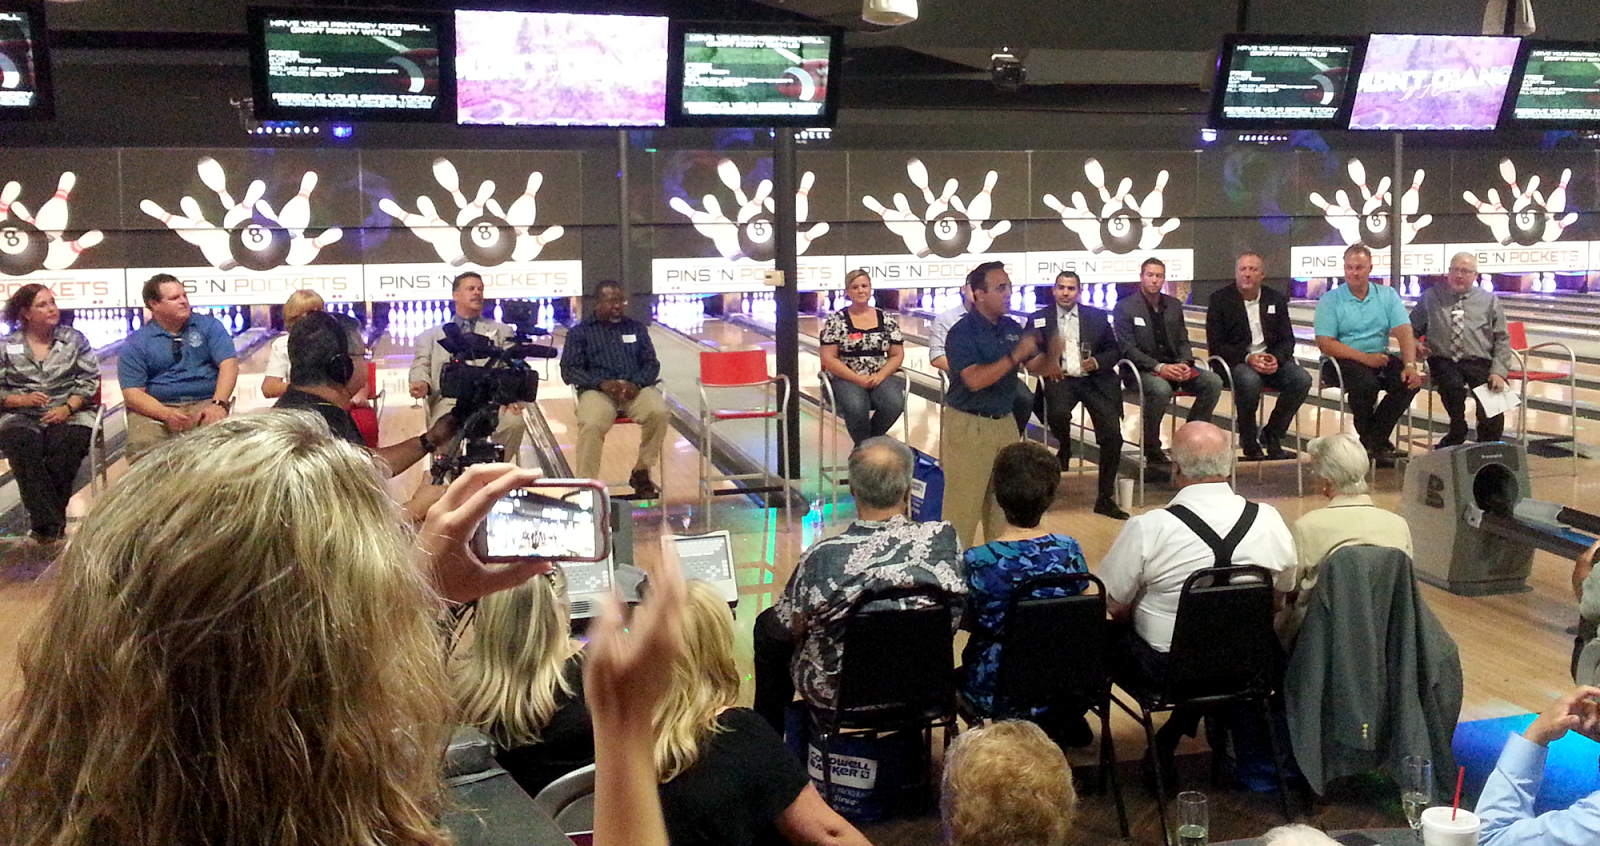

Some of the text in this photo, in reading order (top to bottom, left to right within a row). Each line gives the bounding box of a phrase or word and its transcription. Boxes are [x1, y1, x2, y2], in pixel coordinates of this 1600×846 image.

[754, 223, 765, 236] 8
[940, 220, 951, 234] 8
[1113, 218, 1124, 230] 8
[4, 230, 20, 246] 8
[249, 228, 264, 243] 8
[478, 226, 492, 240] 8
[1302, 256, 1337, 267] PINS
[1510, 250, 1578, 262] POCKETS
[906, 265, 922, 277] 'N
[1038, 261, 1076, 273] PINS
[380, 276, 430, 289] PINS
[483, 272, 568, 286] OCKETS
[667, 269, 710, 282] PINS
[717, 269, 734, 281] 'N
[205, 280, 226, 293] 'N
[234, 277, 347, 292] POCKETS
[810, 758, 857, 778] BAKER
